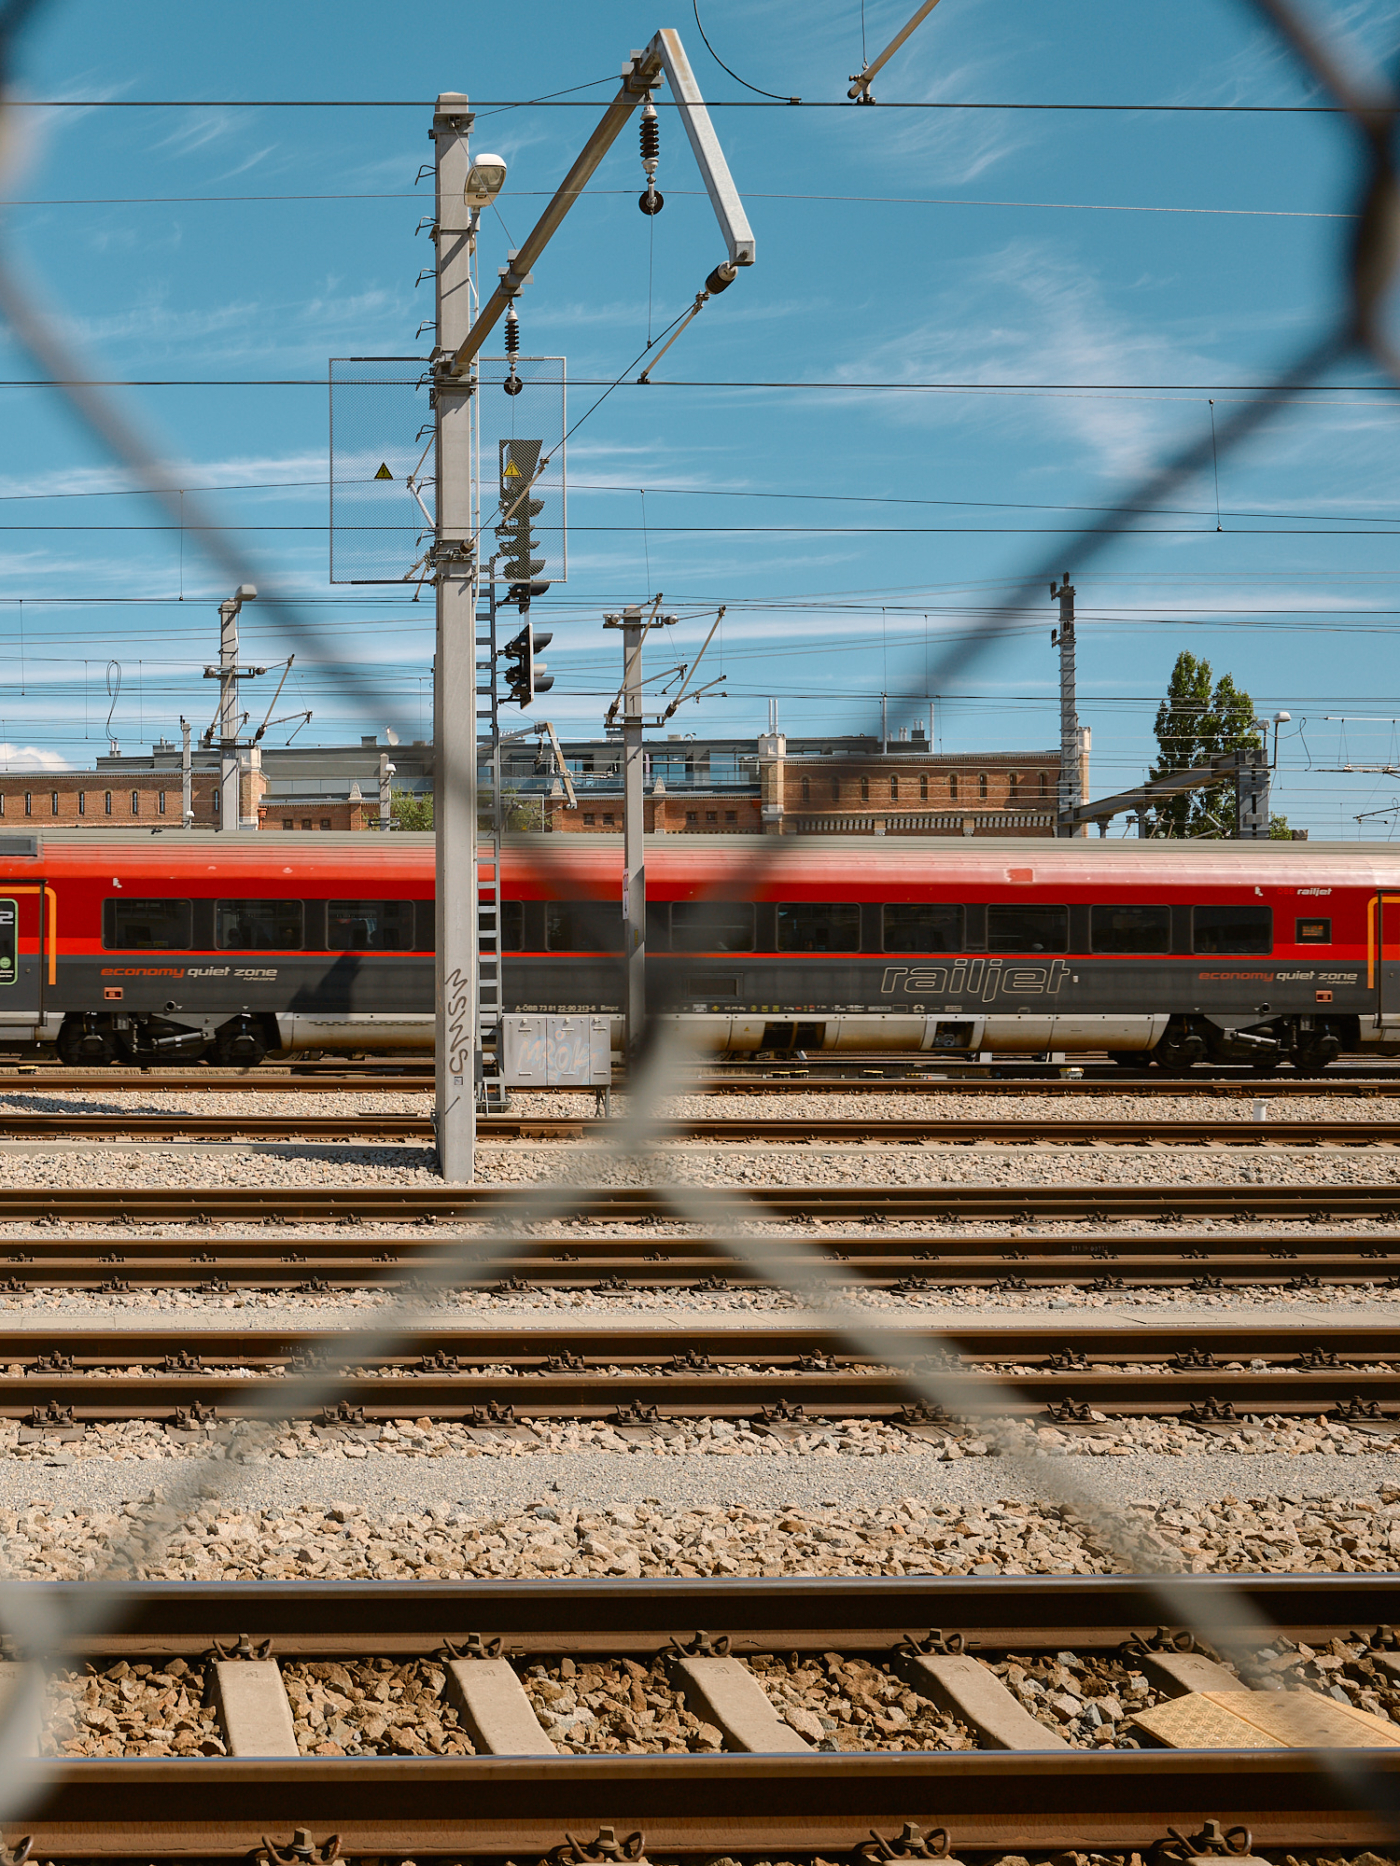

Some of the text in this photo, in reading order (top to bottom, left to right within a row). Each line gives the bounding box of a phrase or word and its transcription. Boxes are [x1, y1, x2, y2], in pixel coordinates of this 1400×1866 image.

[1296, 887, 1332, 897] railjet
[100, 966, 278, 979] economy quiet zone
[1198, 970, 1358, 982] economy quiet zone
[880, 958, 1071, 1002] railjet
